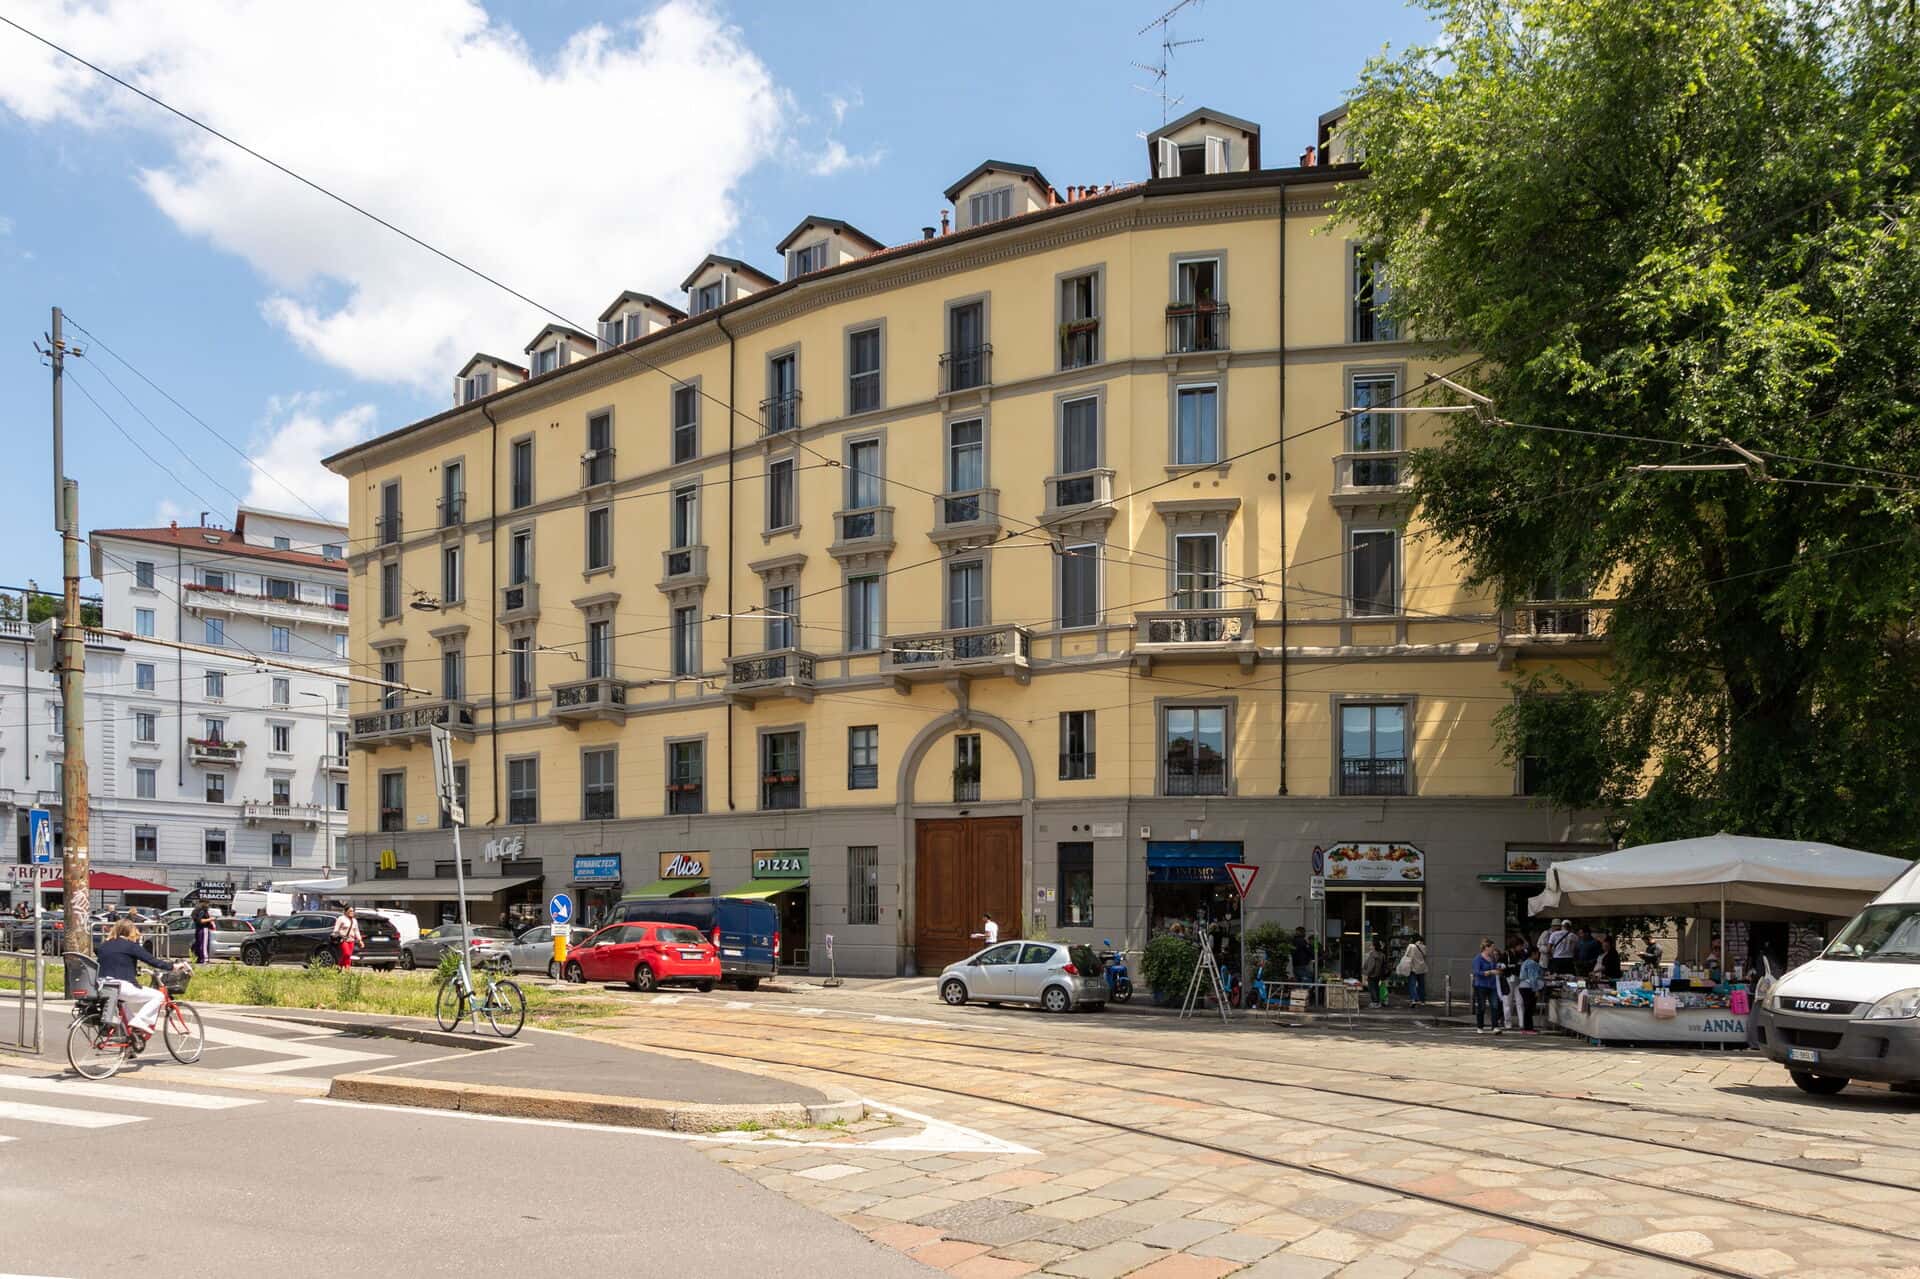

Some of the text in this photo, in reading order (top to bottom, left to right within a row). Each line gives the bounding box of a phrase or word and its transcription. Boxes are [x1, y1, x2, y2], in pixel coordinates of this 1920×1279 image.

[666, 855, 702, 876] Alice
[758, 859, 801, 871] PIZZA
[1795, 1000, 1830, 1010] IVECO
